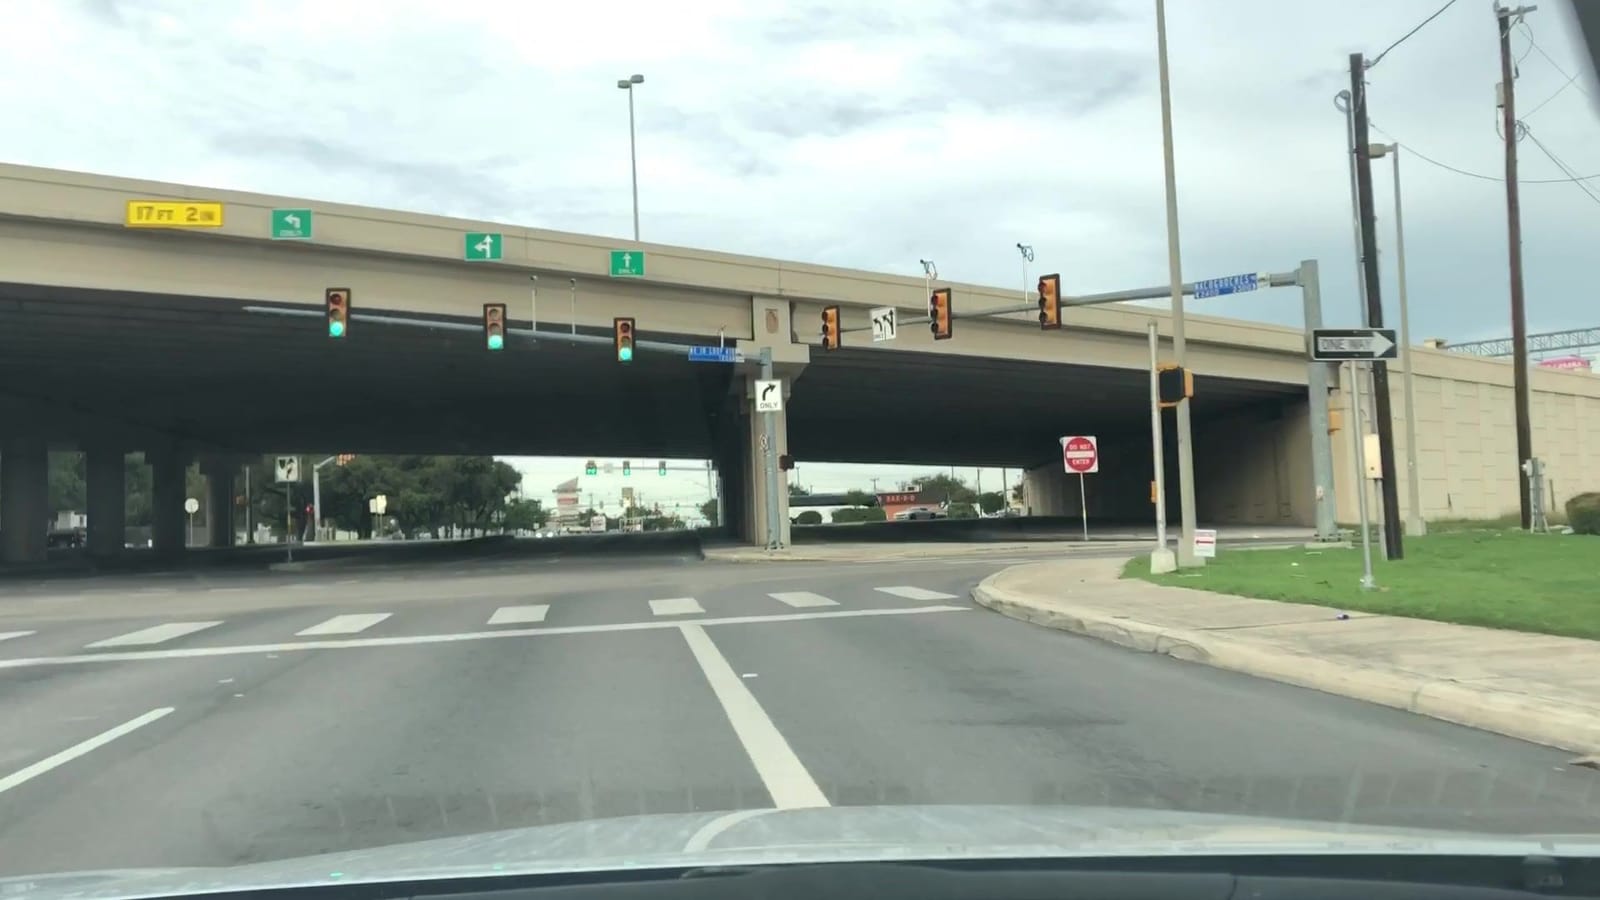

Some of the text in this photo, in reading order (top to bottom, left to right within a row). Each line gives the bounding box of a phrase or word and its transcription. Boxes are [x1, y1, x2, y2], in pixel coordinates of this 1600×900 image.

[136, 206, 154, 220] 17
[157, 209, 174, 220] FT
[186, 207, 198, 221] 2
[1320, 338, 1372, 350] ONE WAY
